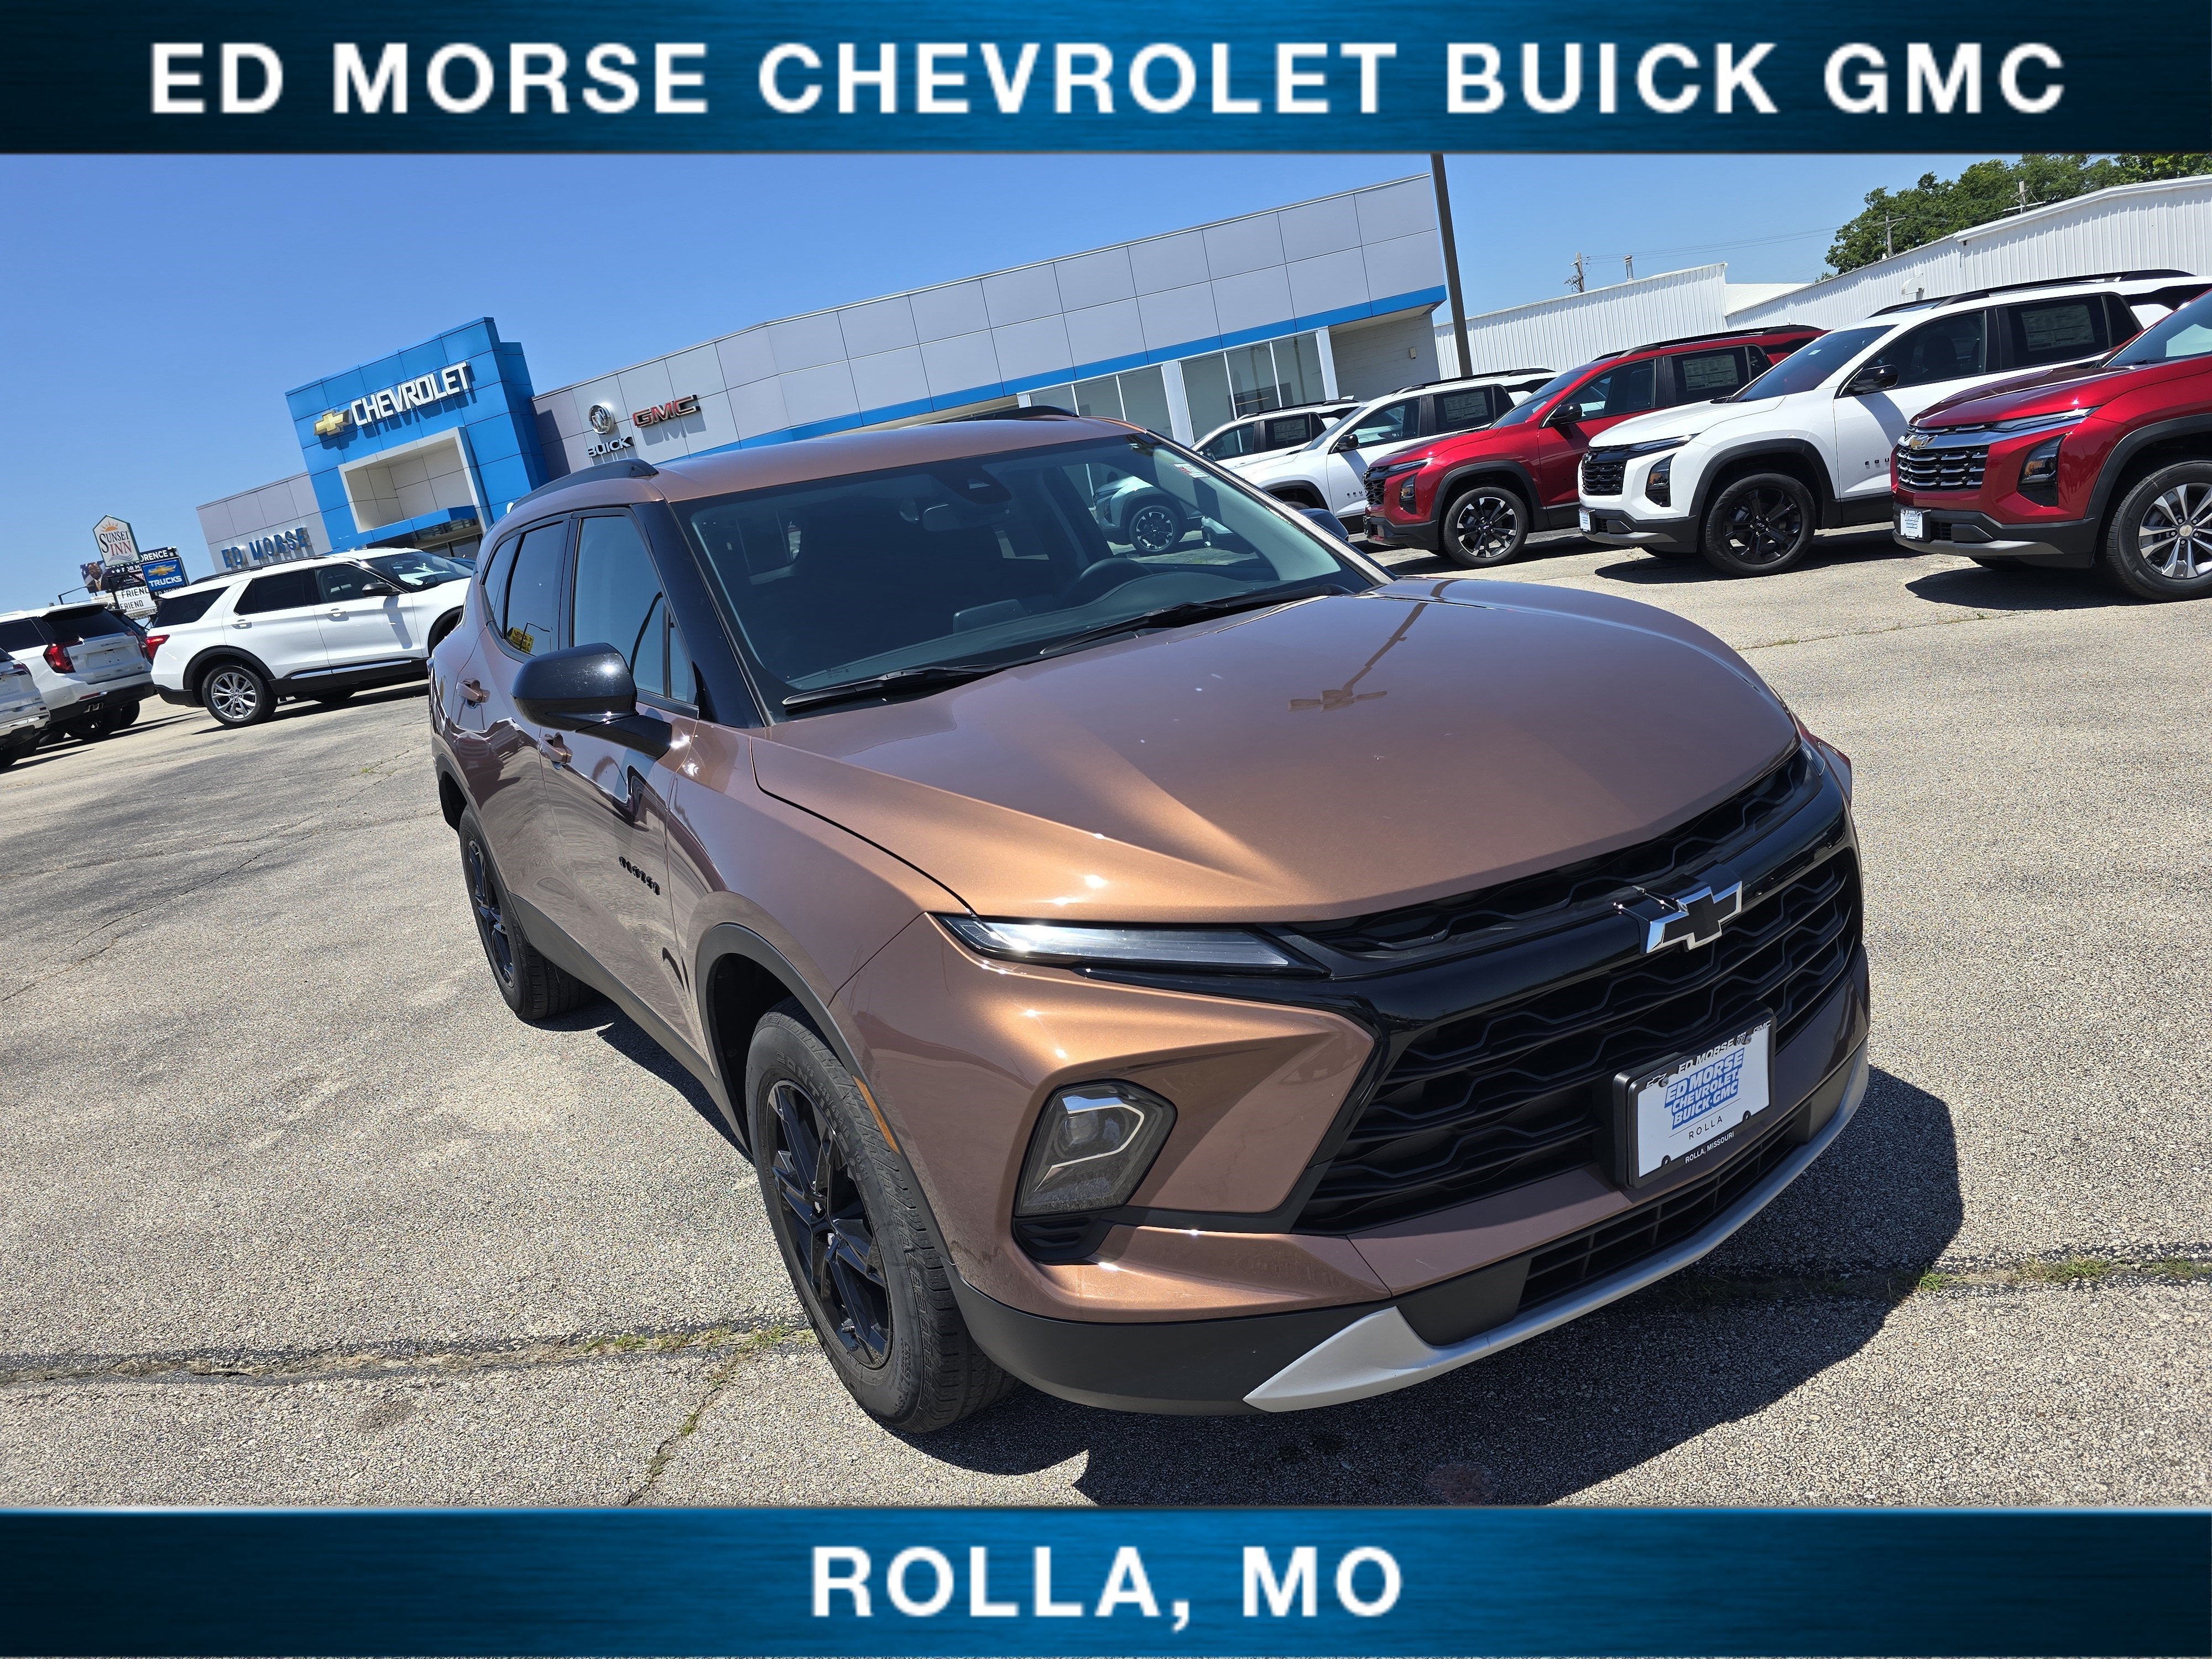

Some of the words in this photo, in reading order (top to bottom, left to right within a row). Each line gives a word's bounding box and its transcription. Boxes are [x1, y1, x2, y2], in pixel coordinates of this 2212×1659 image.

[351, 361, 468, 426] CHEVROLET
[632, 394, 700, 429] GMC
[587, 436, 632, 457] BUICK
[99, 530, 130, 553] SUNSET
[110, 540, 133, 556] INN
[221, 546, 243, 568] ED
[248, 527, 309, 561] MORSE
[148, 575, 182, 587] TRUCKS
[119, 599, 144, 611] FRIEND
[1678, 1059, 1694, 1075] ED
[1695, 1037, 1734, 1066] MORSE
[1753, 1020, 1772, 1035] GMC
[1666, 1079, 1688, 1104] ED
[1688, 1050, 1744, 1092] MORSE
[1689, 1115, 1723, 1140] ROLLA
[1685, 1146, 1706, 1164] ROLLA,
[1707, 1131, 1734, 1152] MISSOURI
